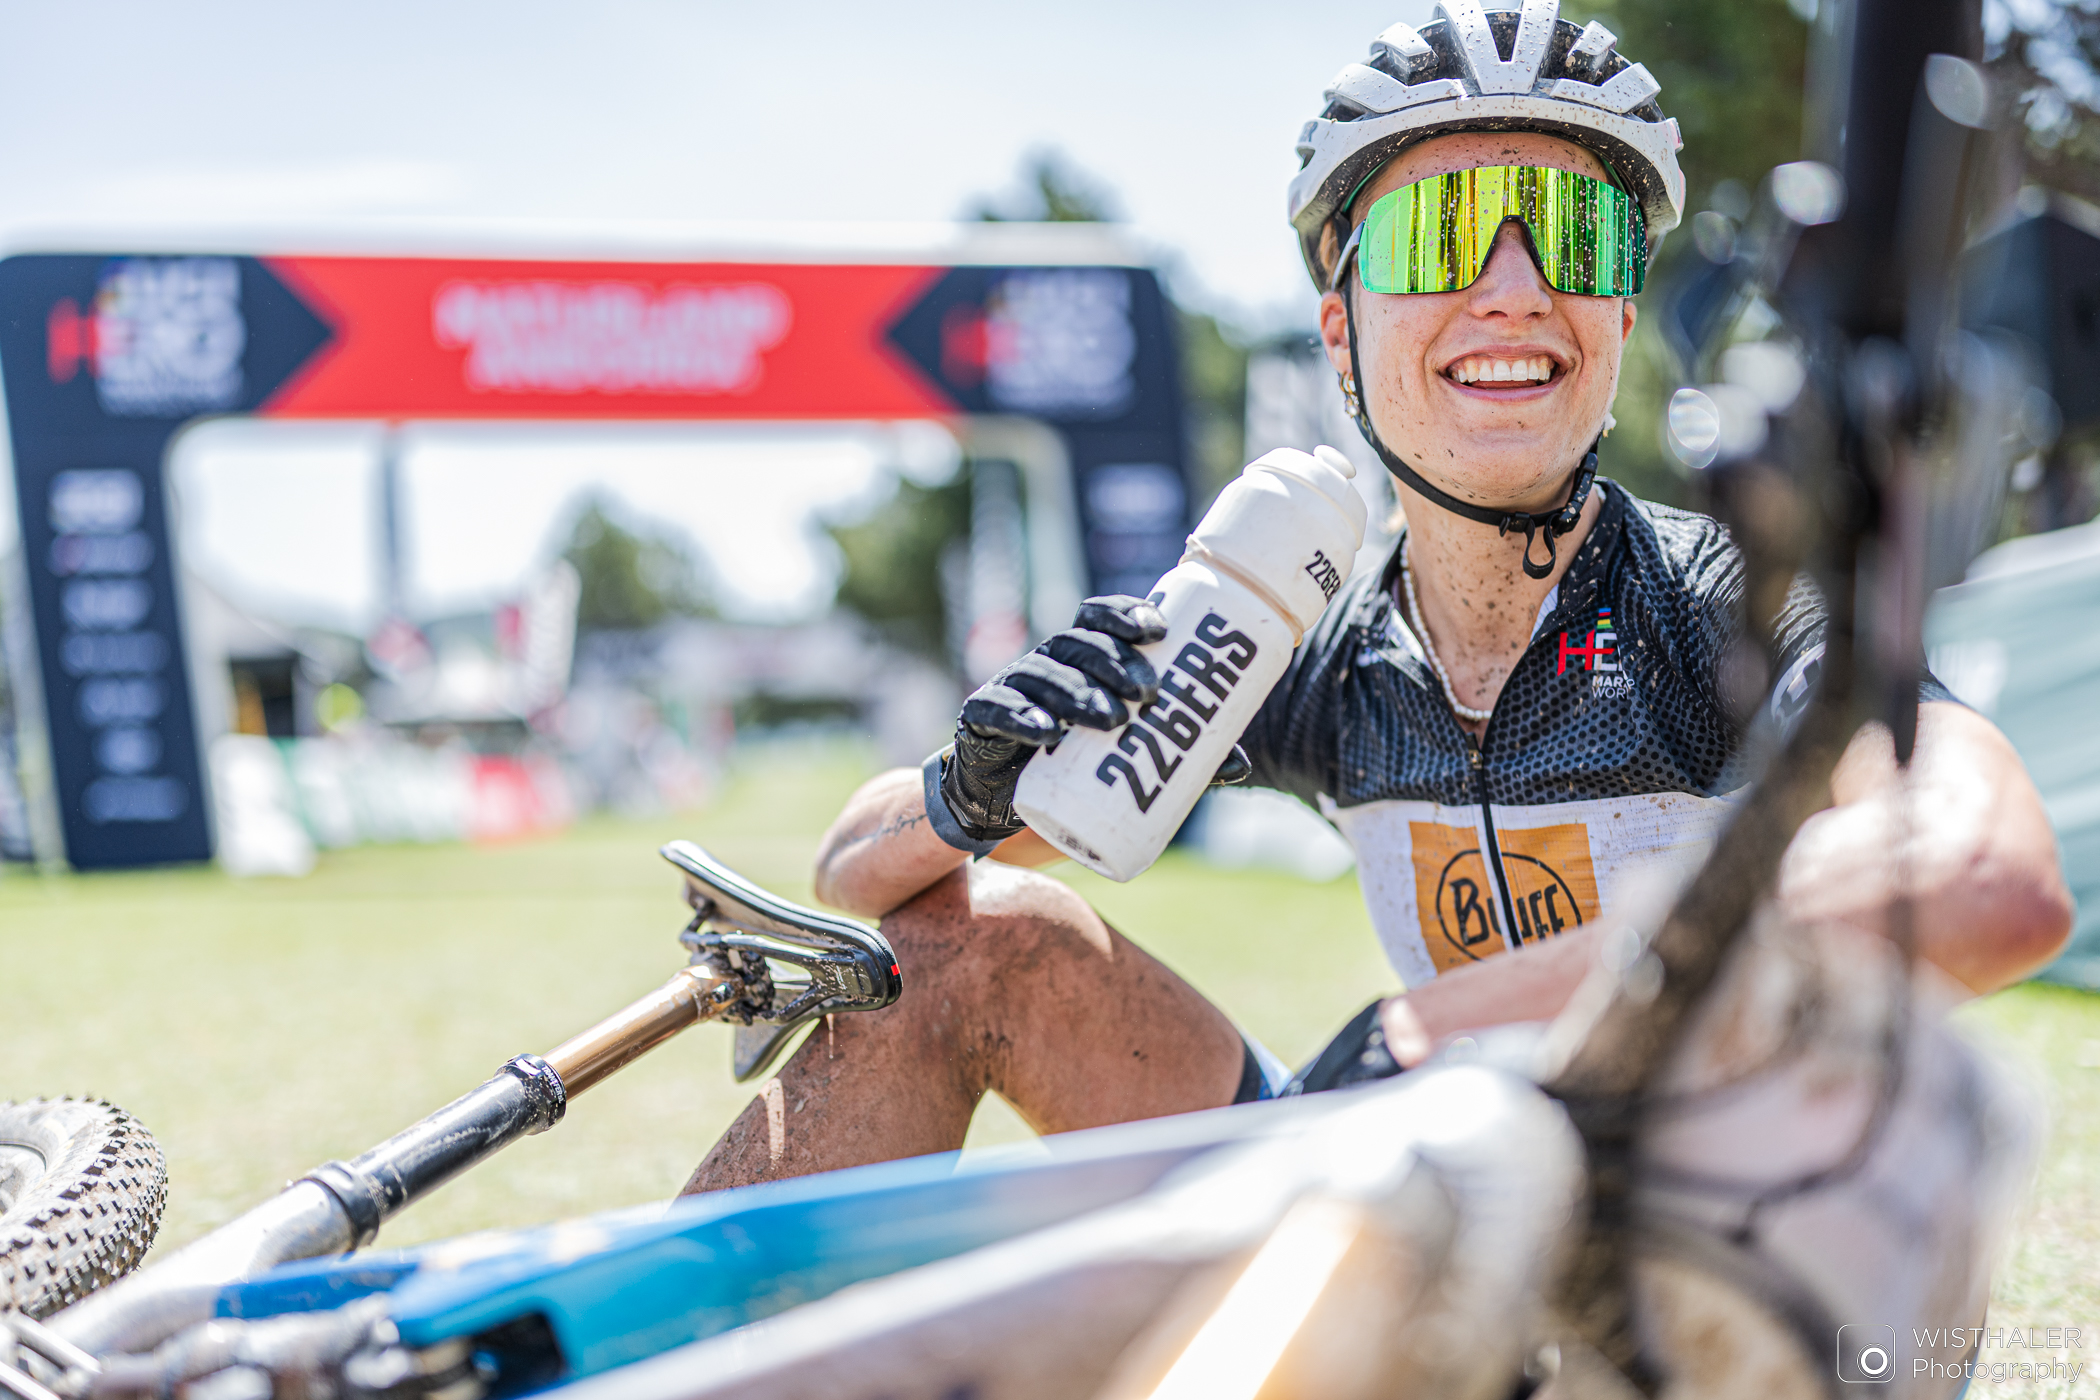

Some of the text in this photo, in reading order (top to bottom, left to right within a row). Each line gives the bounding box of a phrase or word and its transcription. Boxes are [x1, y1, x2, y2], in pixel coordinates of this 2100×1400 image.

[1305, 550, 1341, 605] 226ER
[1592, 675, 1627, 688] MAR
[1592, 687, 1629, 699] WOR
[1096, 612, 1258, 814] 226ERS
